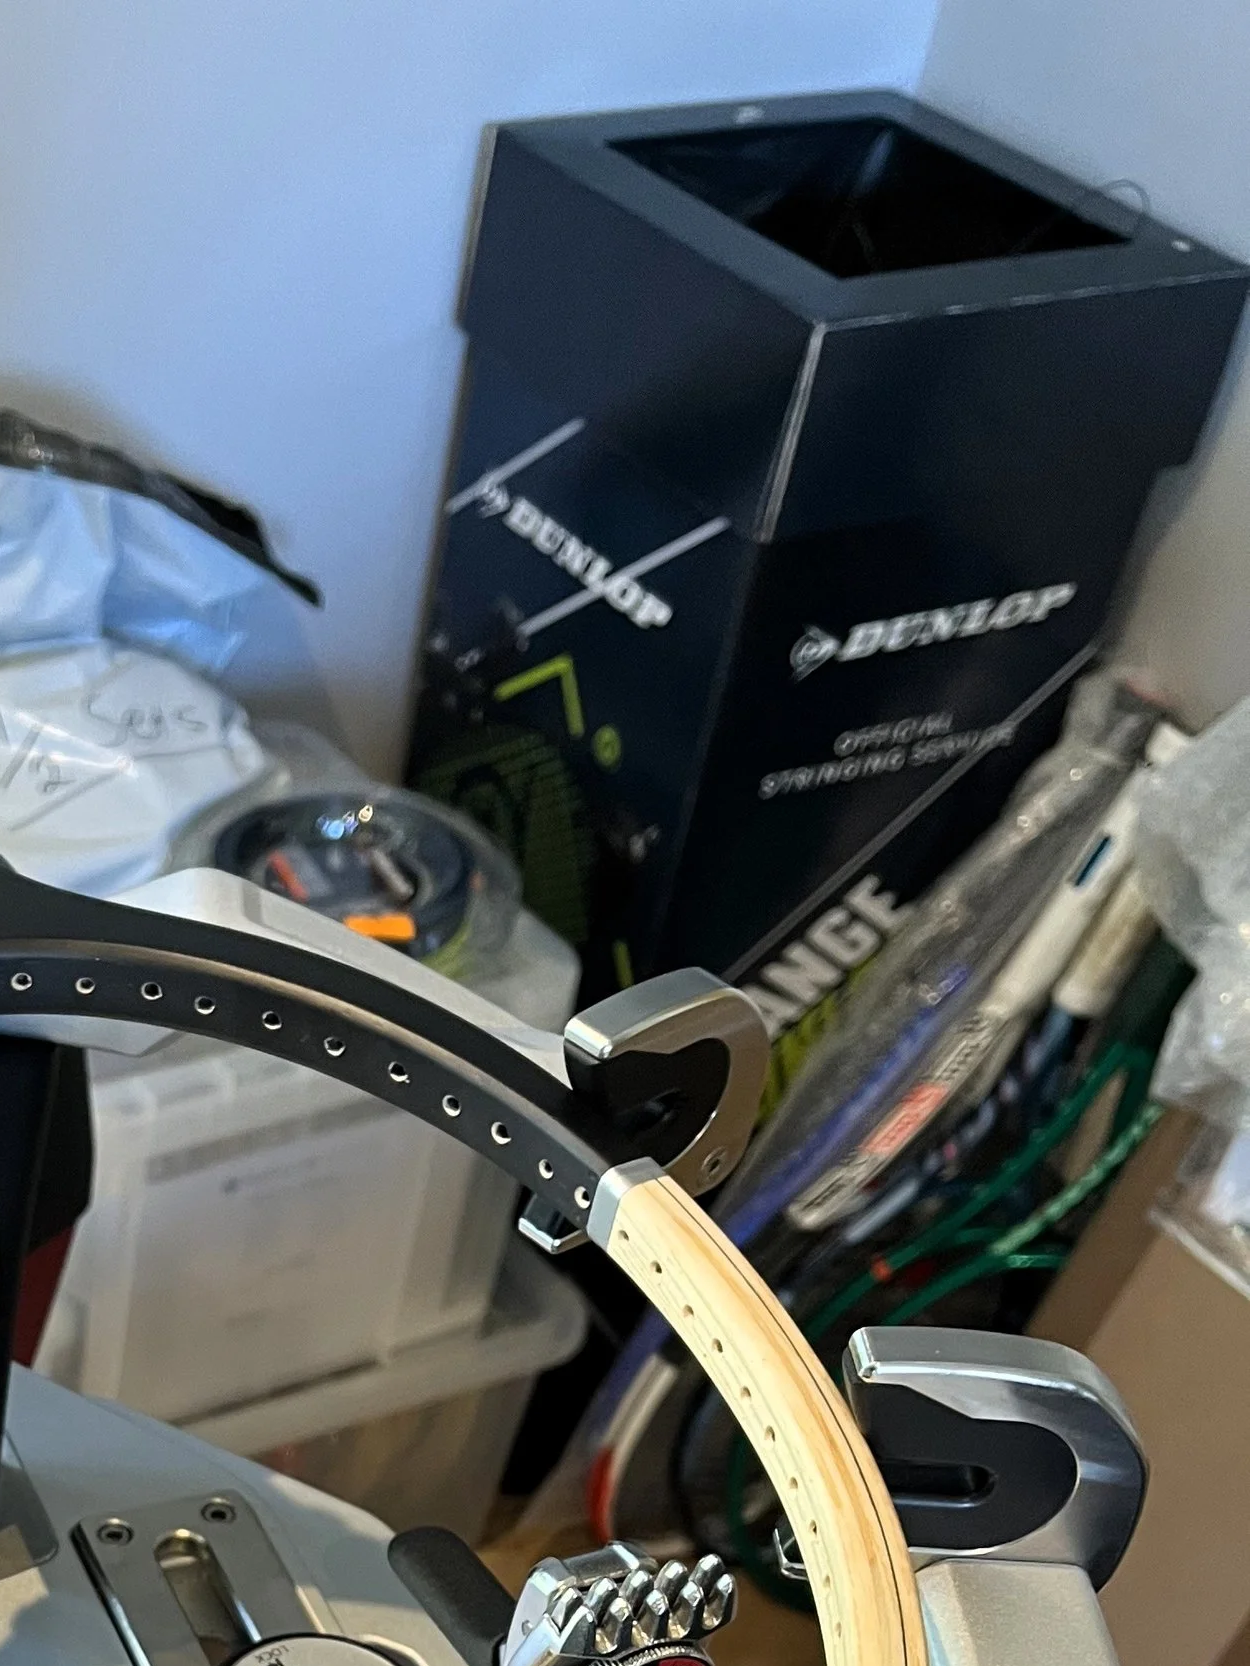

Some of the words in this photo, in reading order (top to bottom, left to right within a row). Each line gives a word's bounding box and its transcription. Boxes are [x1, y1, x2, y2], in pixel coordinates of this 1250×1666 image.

[502, 497, 674, 630] DUNLOP
[836, 582, 1078, 662] DUNLOP
[254, 1644, 290, 1663] LOCK
